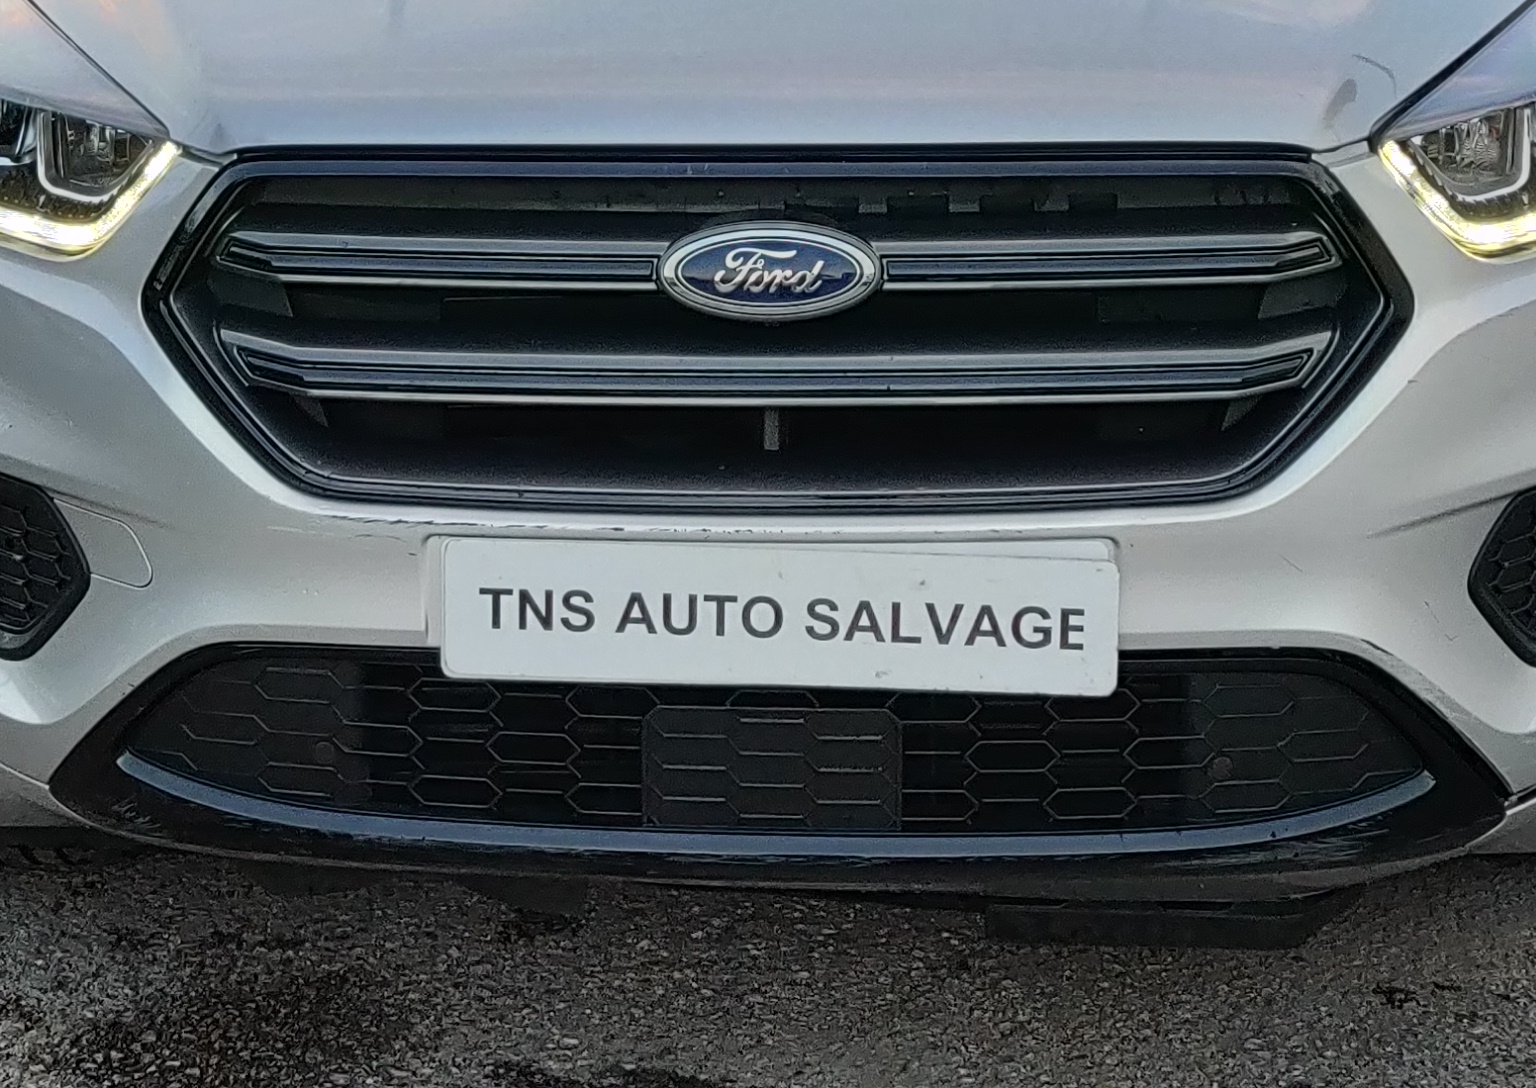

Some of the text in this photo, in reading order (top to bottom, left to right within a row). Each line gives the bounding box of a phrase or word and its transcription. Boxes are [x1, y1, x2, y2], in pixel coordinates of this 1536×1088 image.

[714, 247, 825, 294] Ford
[478, 587, 1085, 652] TNS AUTO SALVAGE
